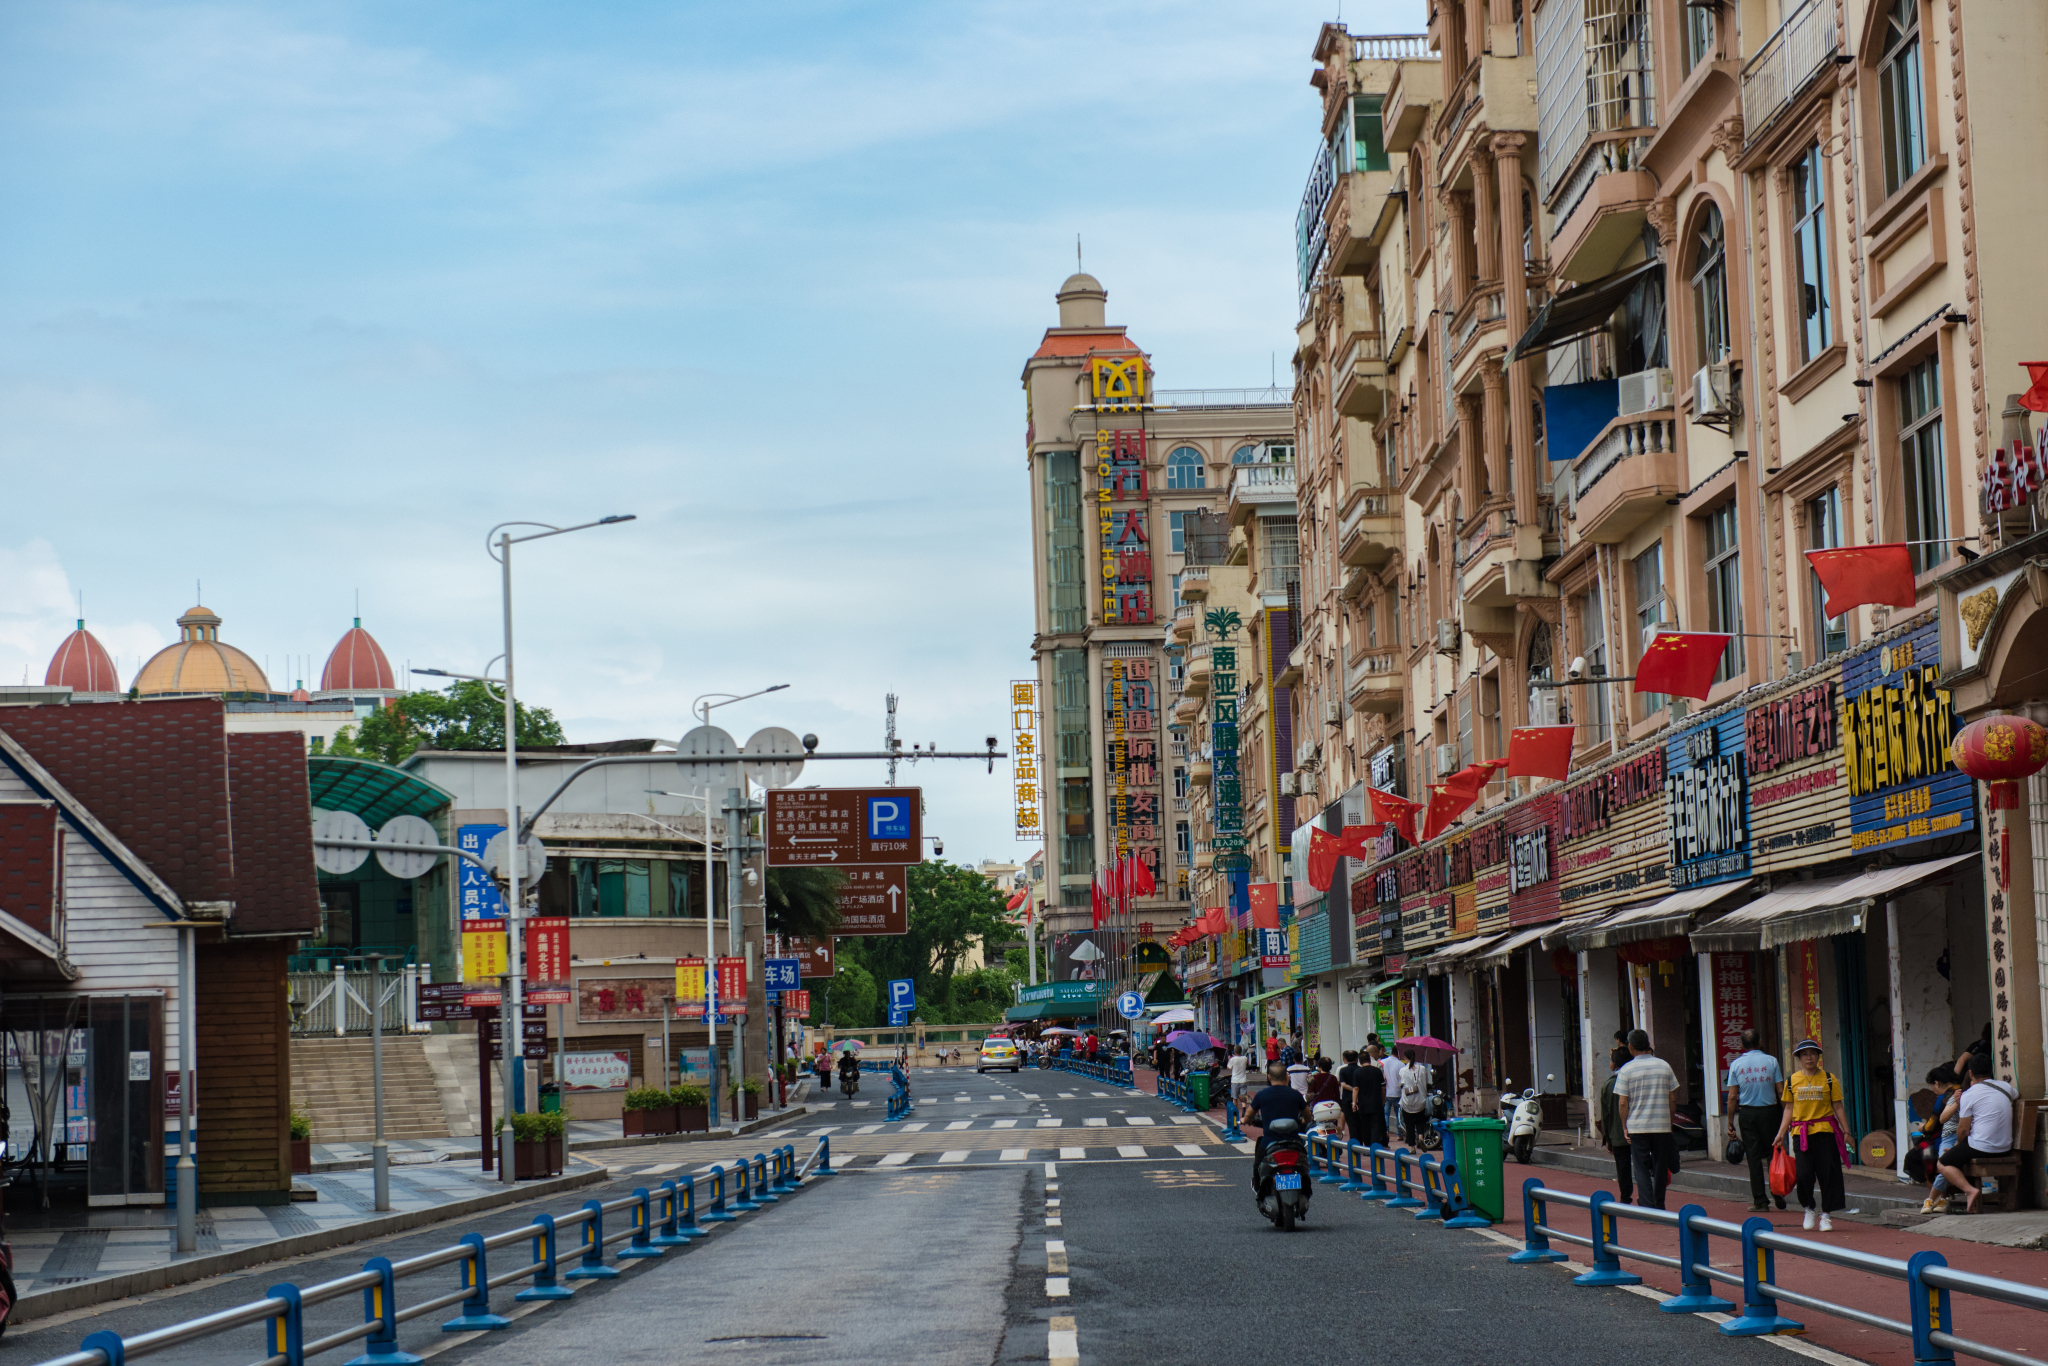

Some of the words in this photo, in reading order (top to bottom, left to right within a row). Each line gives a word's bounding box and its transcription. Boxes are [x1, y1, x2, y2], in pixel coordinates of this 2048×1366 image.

[1096, 429, 1110, 477] GUO
[1098, 488, 1113, 534] MEN
[1113, 428, 1153, 624] 国门大酒店
[1101, 549, 1116, 624] HOTEL
[1112, 659, 1123, 680] GUO
[1112, 681, 1123, 701] MEN
[1113, 701, 1126, 774] INTERNATIONAL
[1013, 684, 1039, 828] 国门名品商场
[776, 793, 828, 802] 辉达口岸城
[1664, 751, 1744, 866] 青年国际旅行社
[776, 810, 849, 818] 华美达广场酒店
[872, 801, 899, 836] P
[776, 822, 849, 831] 维也纳国际酒店
[871, 842, 908, 851] 直行10米
[1215, 839, 1245, 847] 直入20米
[788, 853, 817, 861] 南天王府
[1516, 825, 1549, 888] 蜜雪冰城
[538, 933, 549, 981] 坐拥北仑河
[598, 988, 644, 1013] 东兴
[893, 982, 909, 1003] P
[1123, 996, 1137, 1013] P
[1277, 1181, 1300, 1190] 86771
